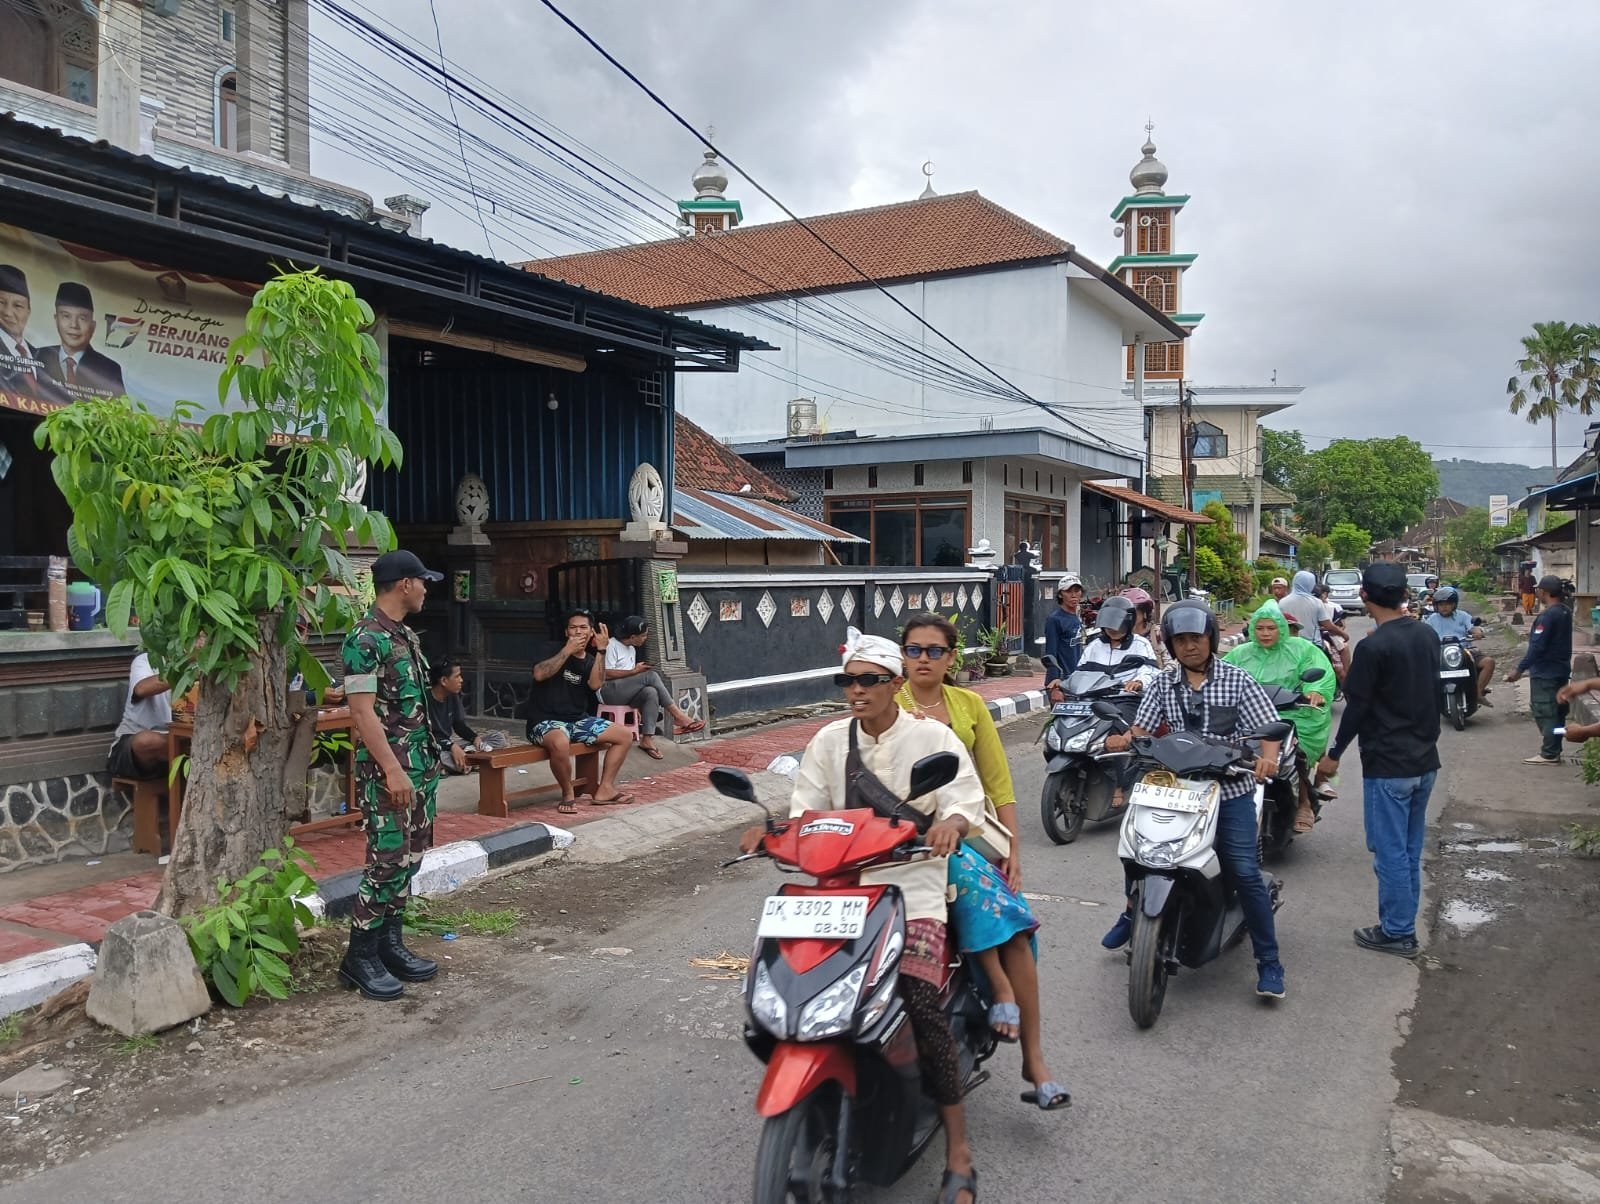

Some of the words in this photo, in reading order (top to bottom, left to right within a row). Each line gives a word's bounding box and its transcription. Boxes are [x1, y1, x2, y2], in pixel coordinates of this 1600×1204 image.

[147, 323, 230, 349] BERJUANG
[147, 340, 195, 360] TIADA
[197, 349, 245, 366] AKHR
[1134, 783, 1149, 795] DK
[765, 900, 787, 916] DK
[793, 900, 833, 916] 3392
